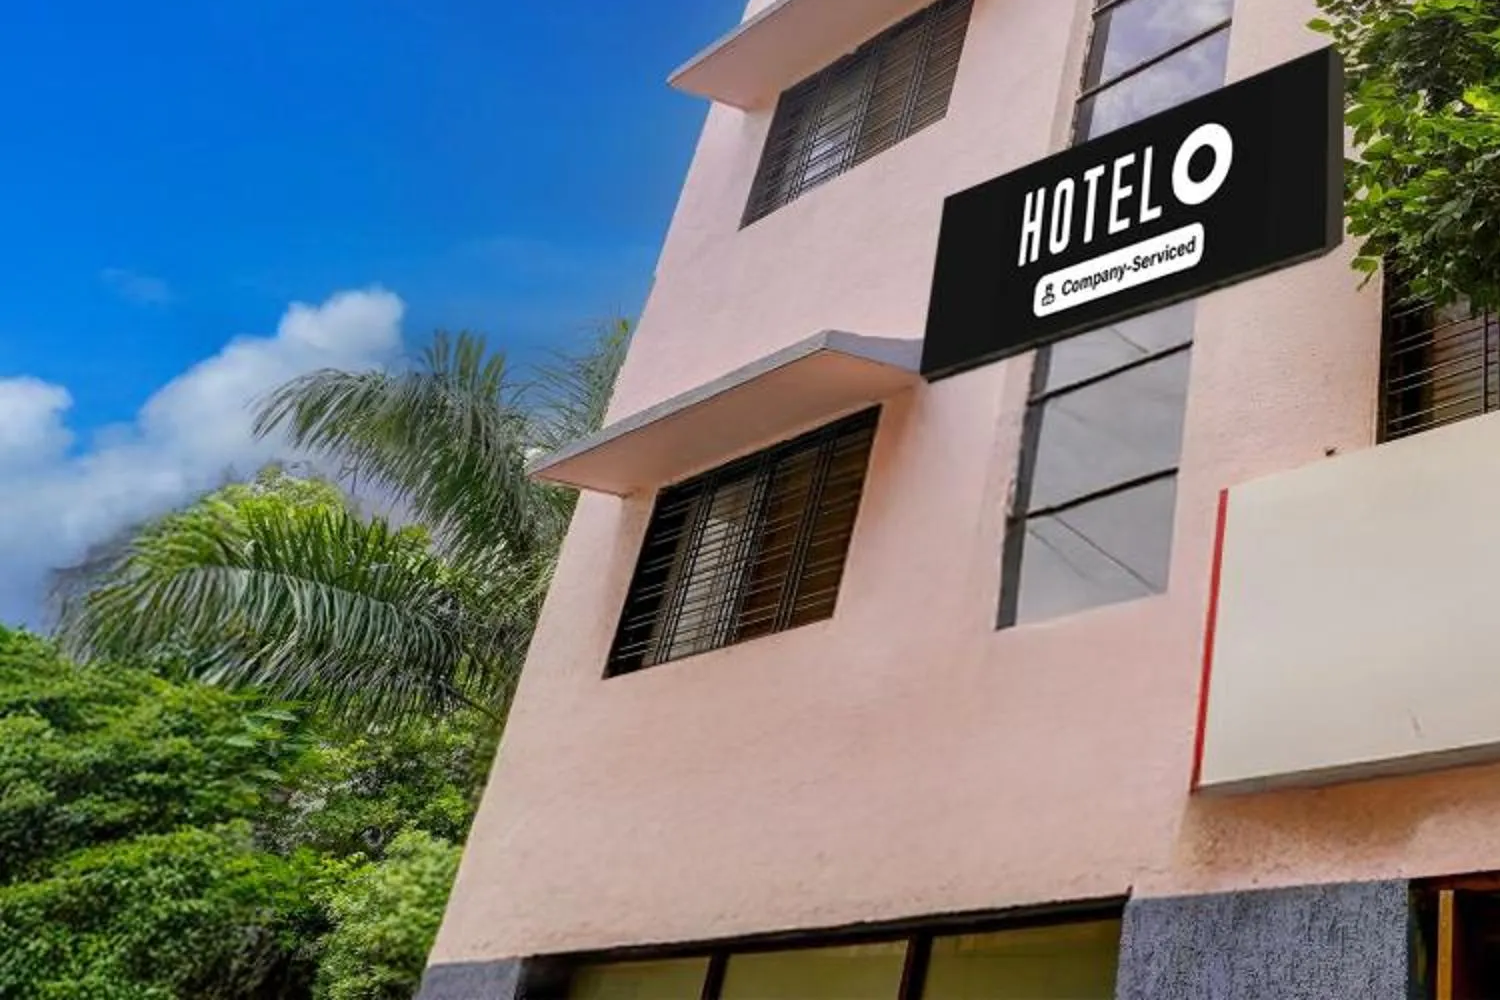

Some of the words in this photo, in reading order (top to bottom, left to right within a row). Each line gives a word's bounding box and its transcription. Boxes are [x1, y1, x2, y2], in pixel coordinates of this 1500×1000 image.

[1017, 145, 1162, 267] HOTEL
[1171, 122, 1233, 205] O
[1060, 237, 1197, 297] Company-Serviced
